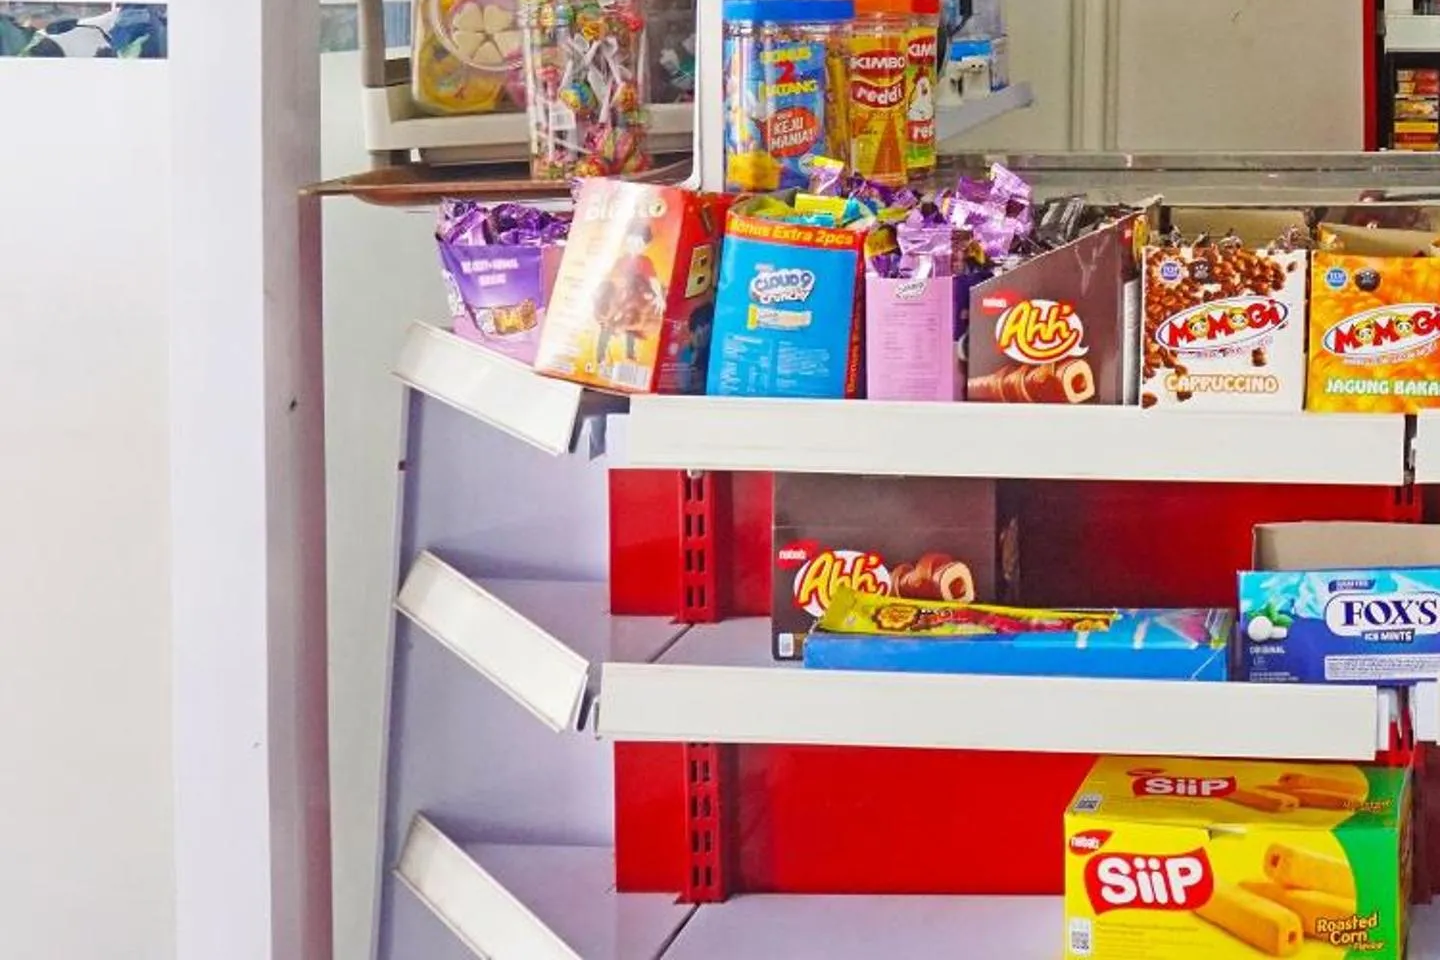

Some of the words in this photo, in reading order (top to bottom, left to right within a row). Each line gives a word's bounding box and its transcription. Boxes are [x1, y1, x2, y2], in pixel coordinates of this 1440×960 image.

[908, 42, 936, 58] KIM
[775, 61, 797, 84] 2
[850, 56, 905, 70] KIMBO
[856, 85, 904, 106] reddi
[772, 117, 805, 135] KEJU
[772, 225, 813, 242] Extra
[815, 229, 854, 246] 2pcs
[754, 271, 800, 290] CLOUD
[801, 271, 812, 287] 9
[1165, 373, 1280, 394] CAPPUCCINO
[1326, 378, 1390, 396] JAGUNG
[1340, 598, 1438, 627] FOX'S
[1380, 630, 1413, 642] MINTS
[1144, 778, 1231, 796] SiiP
[1097, 856, 1204, 905] SiiP
[1316, 913, 1378, 932] Roasted
[1329, 930, 1368, 946] Corn
